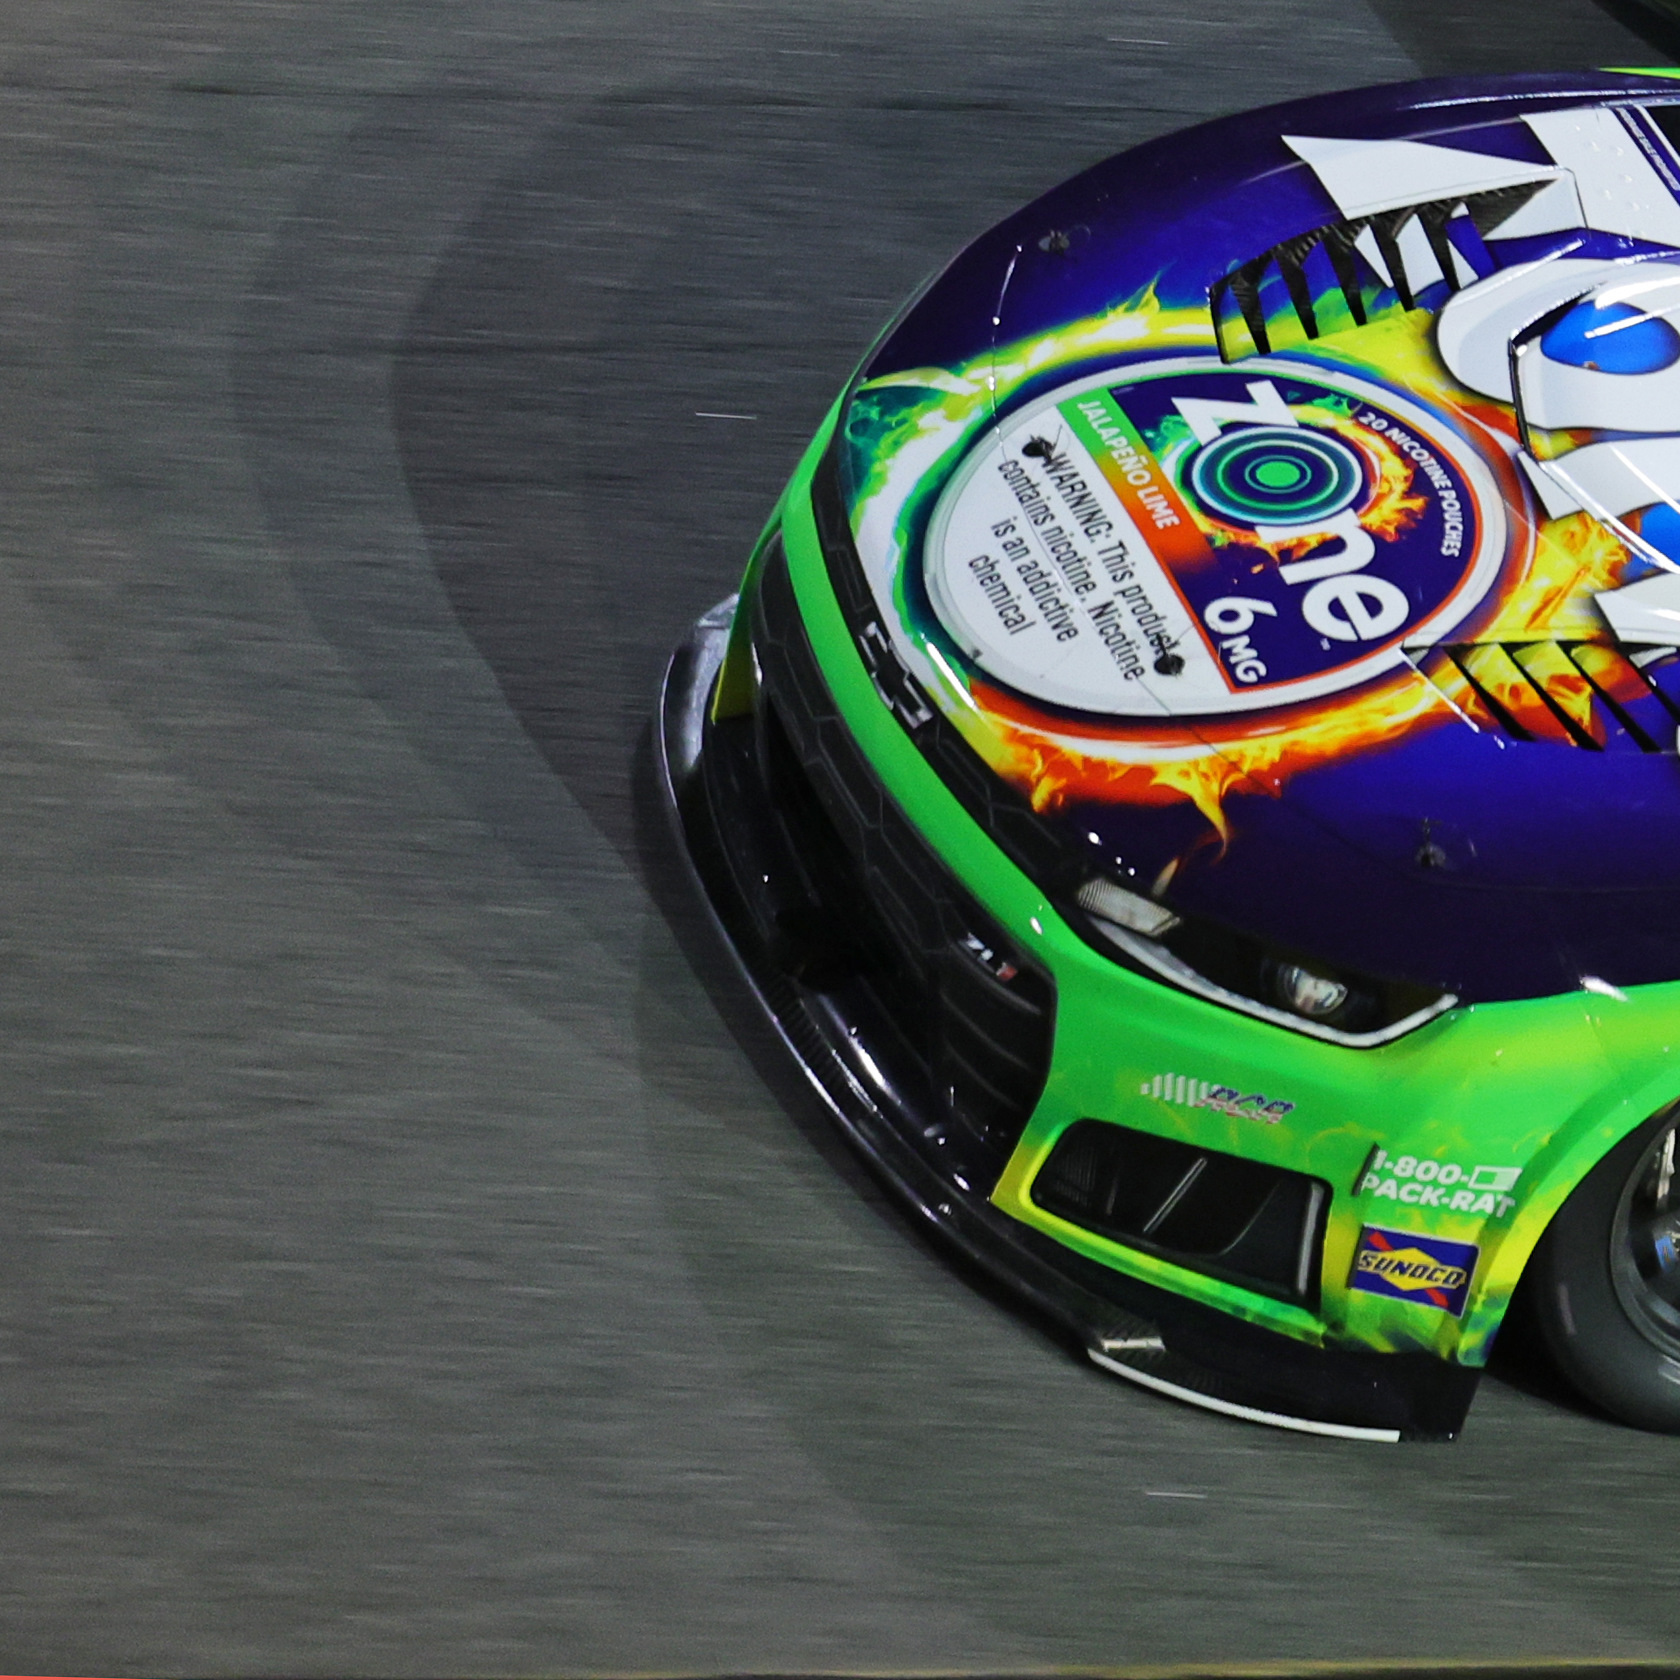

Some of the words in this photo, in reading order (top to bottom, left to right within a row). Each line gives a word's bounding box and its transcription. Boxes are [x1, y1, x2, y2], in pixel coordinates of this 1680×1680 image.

[1077, 400, 1152, 486] JALAPEÑO
[1137, 483, 1181, 530] LIME
[1358, 411, 1388, 432] 20
[1386, 424, 1452, 490] NICOTINE
[1437, 480, 1463, 557] POUCHES
[991, 516, 1016, 538] is
[1045, 453, 1112, 543] WARNING:
[1098, 540, 1136, 583] This
[998, 459, 1055, 526] contains
[1041, 522, 1097, 601] nicotine.
[1088, 600, 1146, 682] Nicotine
[1002, 532, 1030, 562] an
[1017, 558, 1079, 642] addictive
[1204, 597, 1278, 635] 6
[1222, 635, 1268, 683] MG
[1362, 1173, 1516, 1218] PACK-RAT
[1357, 1251, 1467, 1288] SUNOCO
